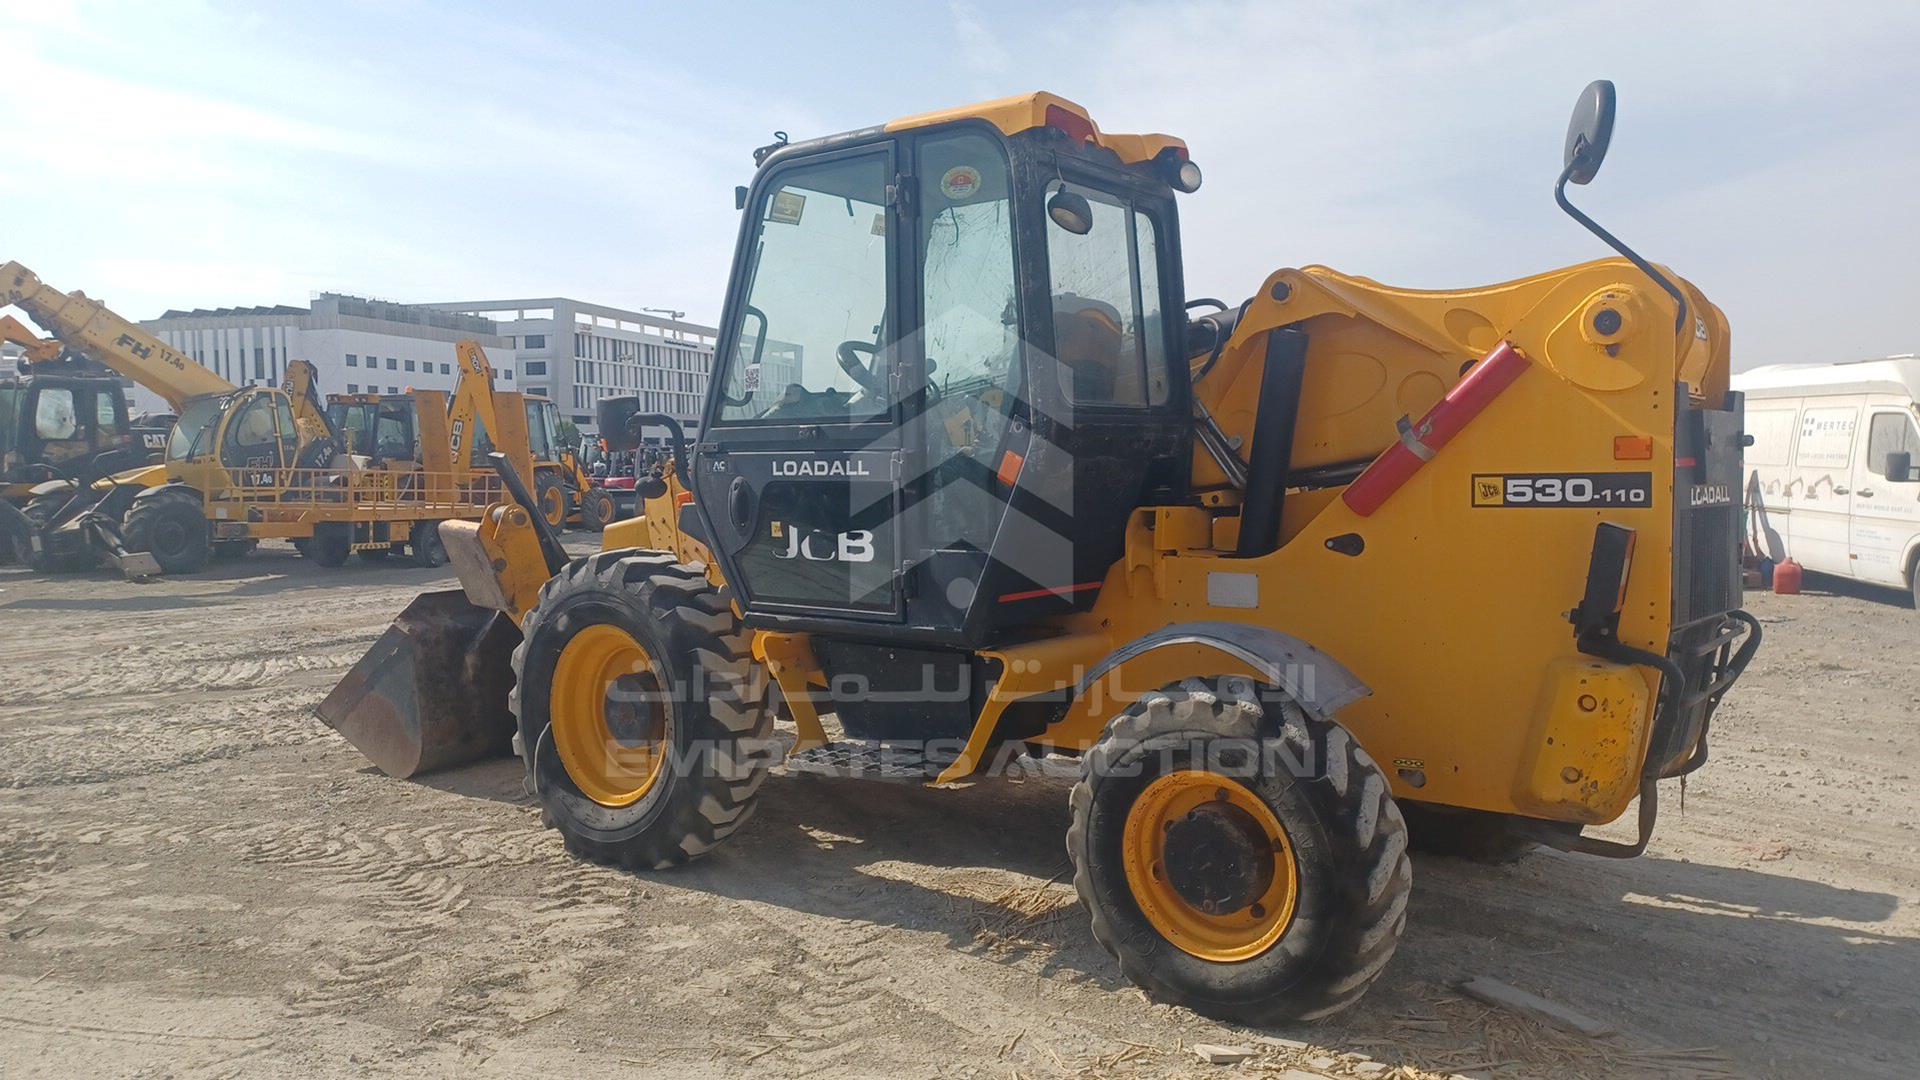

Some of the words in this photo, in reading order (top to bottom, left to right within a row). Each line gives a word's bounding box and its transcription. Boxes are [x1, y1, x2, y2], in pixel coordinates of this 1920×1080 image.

[116, 333, 151, 360] FH
[143, 434, 167, 449] CAT
[772, 460, 869, 476] LOADALL
[1478, 482, 1501, 500] JCB
[1506, 478, 1645, 502] 530-110
[772, 524, 875, 562] JCB
